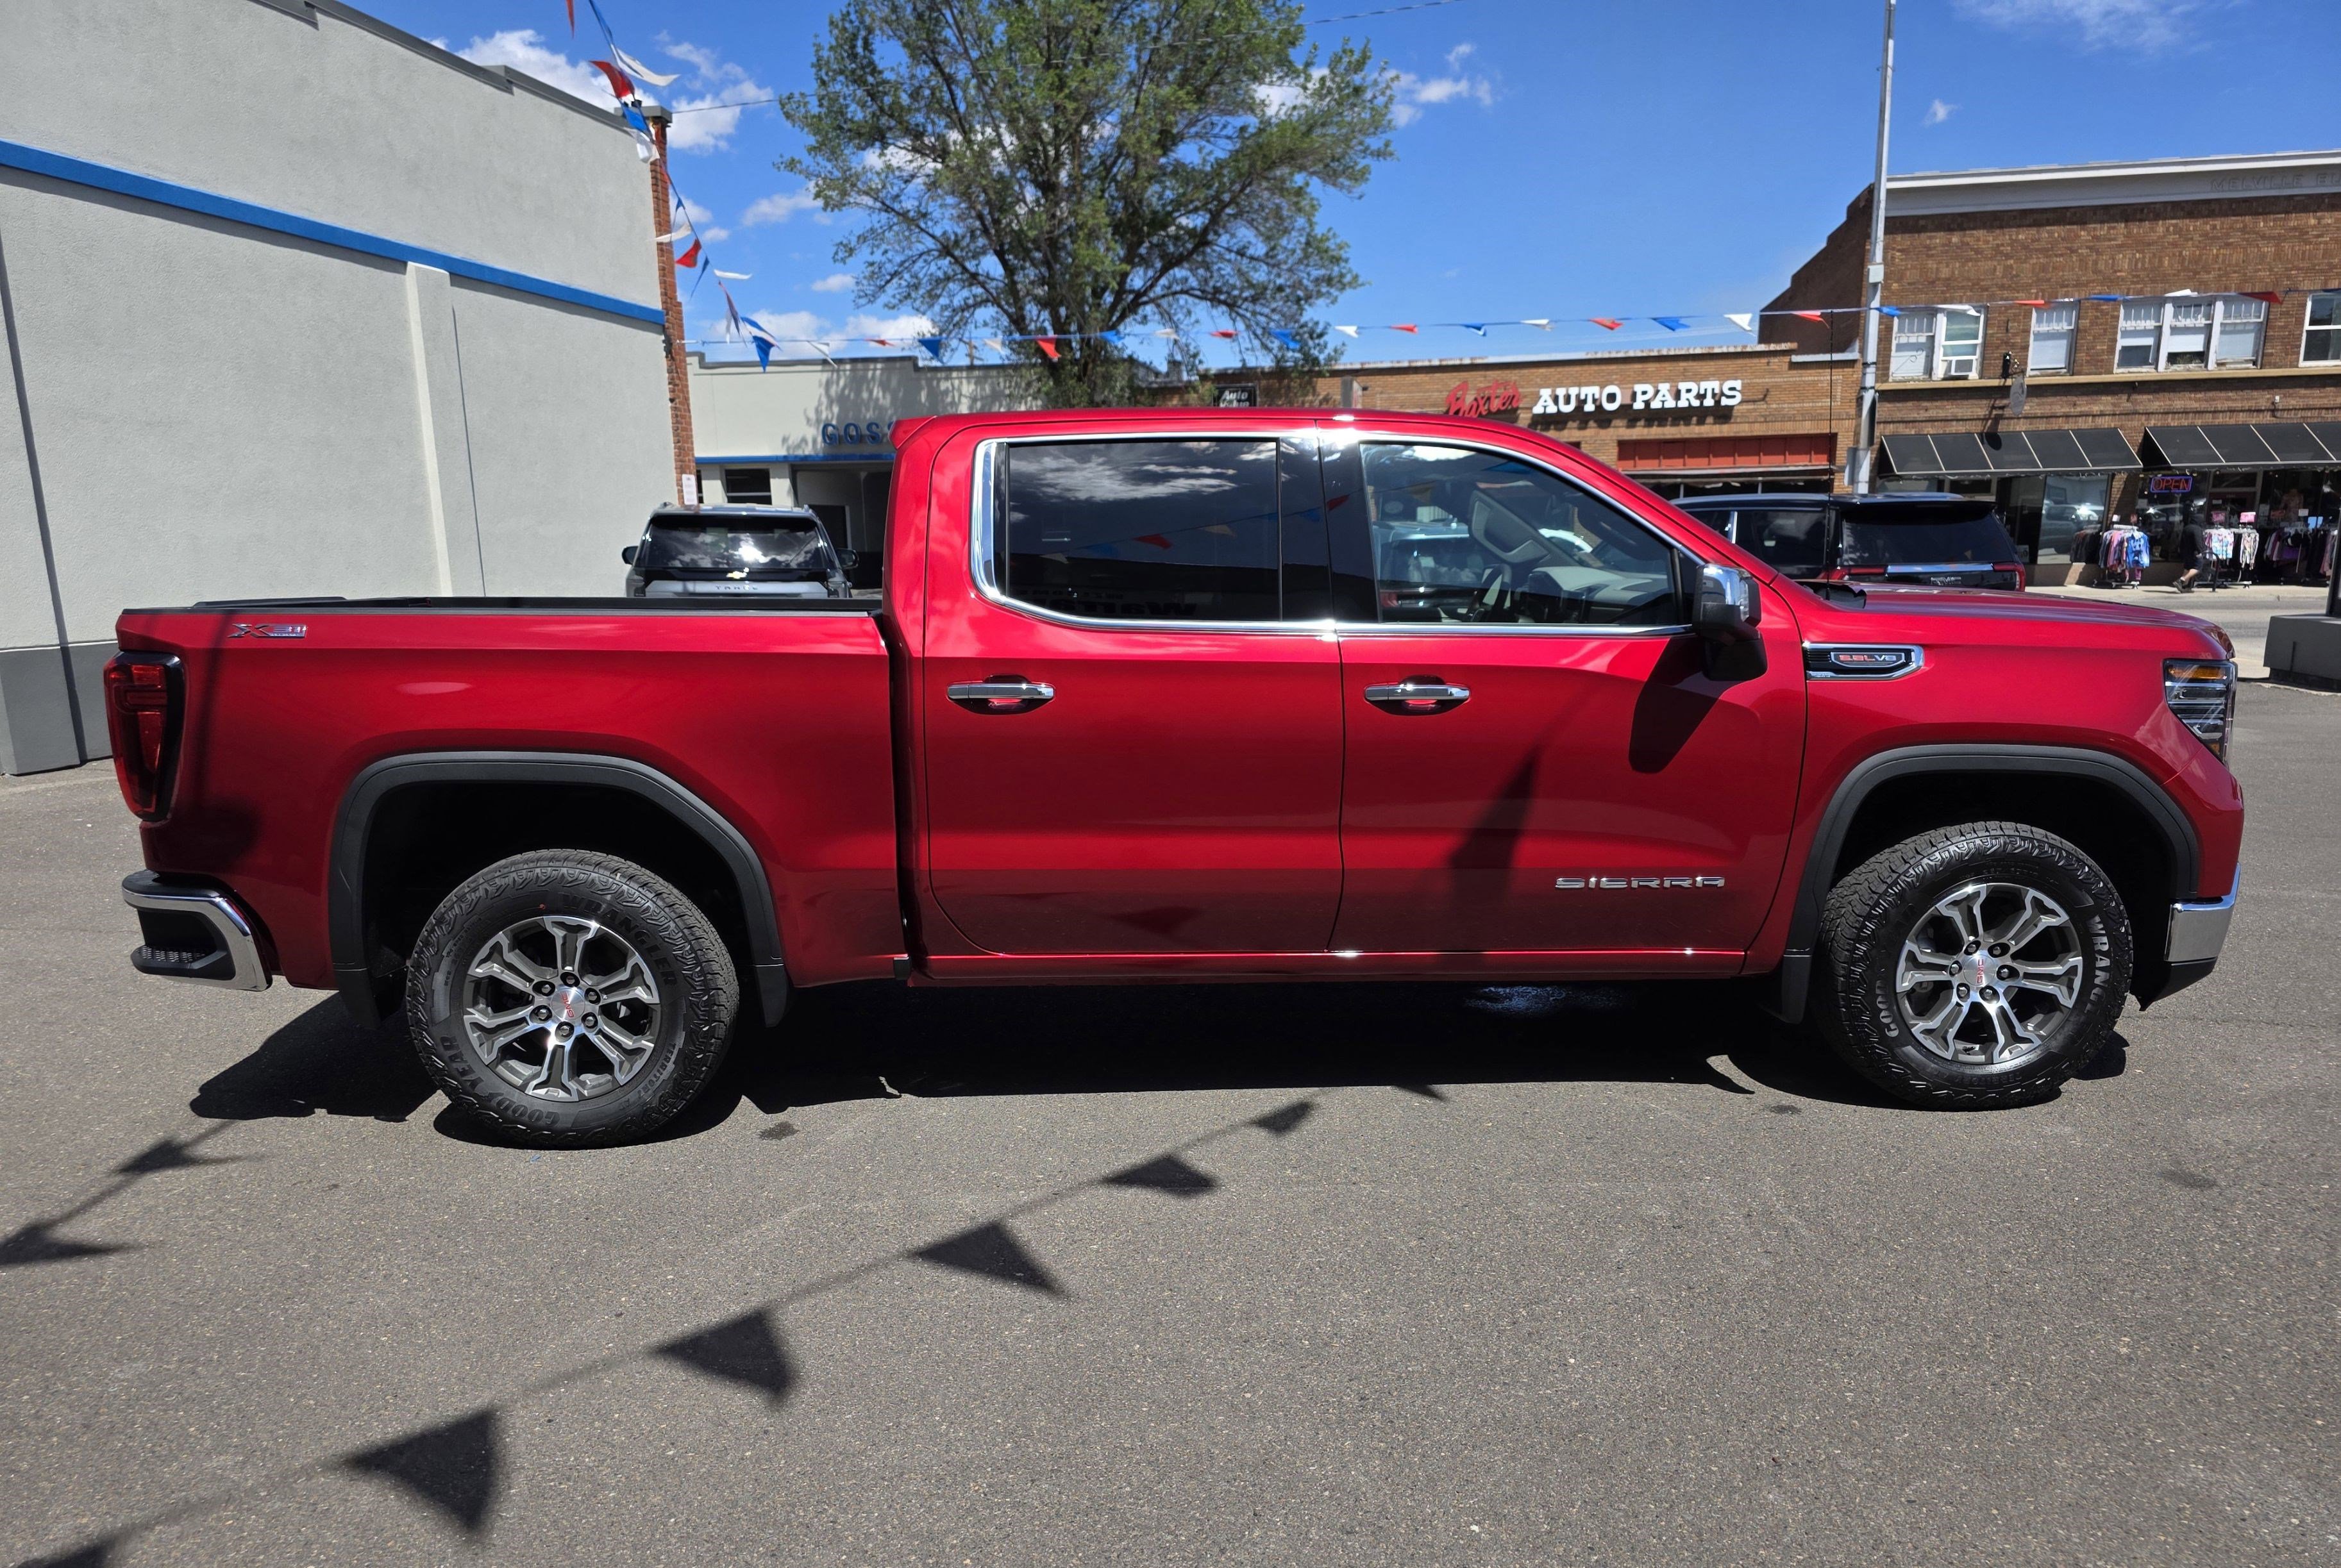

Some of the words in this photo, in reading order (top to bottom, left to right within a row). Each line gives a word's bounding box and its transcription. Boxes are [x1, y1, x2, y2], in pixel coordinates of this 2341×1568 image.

[1220, 390, 1249, 401] Auto
[1532, 385, 1622, 415] AUTO
[1632, 379, 1743, 410] PARTS
[821, 422, 894, 446] GOS
[2152, 478, 2191, 490] OPEN
[1555, 876, 1725, 890] SIERRA
[560, 991, 575, 1018] GMC
